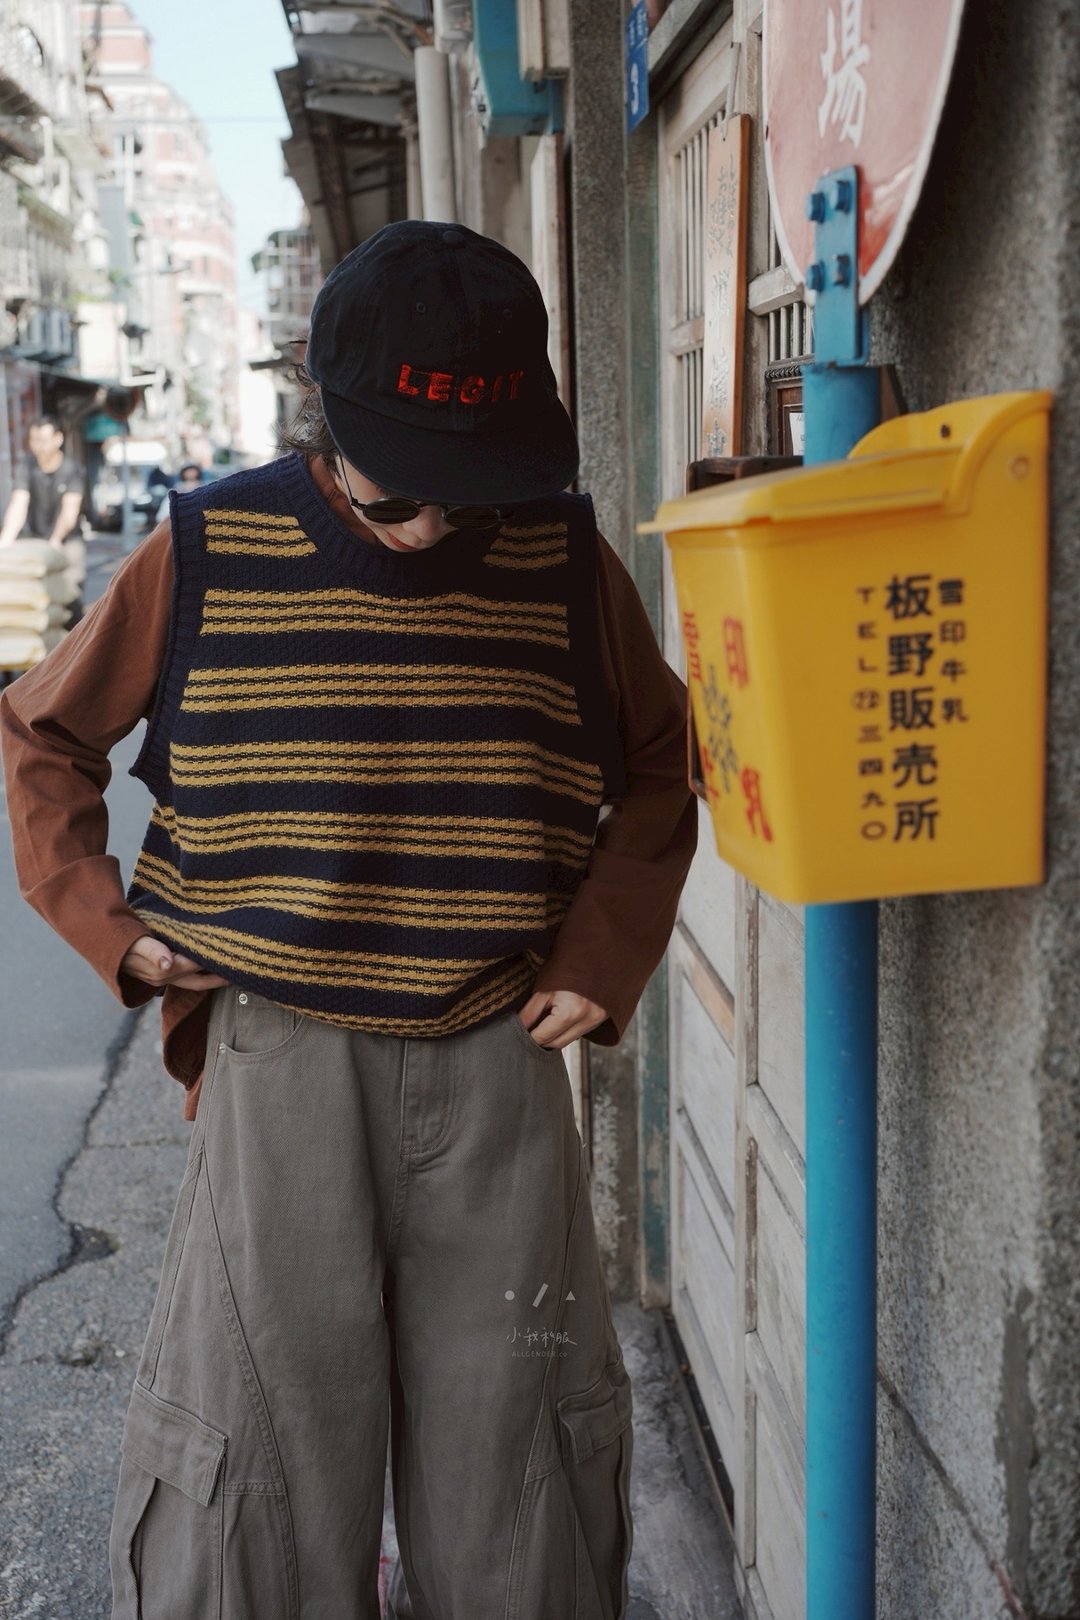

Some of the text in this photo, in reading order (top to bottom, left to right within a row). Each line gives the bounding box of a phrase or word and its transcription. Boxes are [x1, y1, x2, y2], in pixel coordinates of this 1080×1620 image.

[818, 0, 871, 149] 場
[397, 364, 524, 404] LEGIT
[885, 574, 939, 842] 板野販売所
[938, 579, 968, 723] 雪印牛乳
